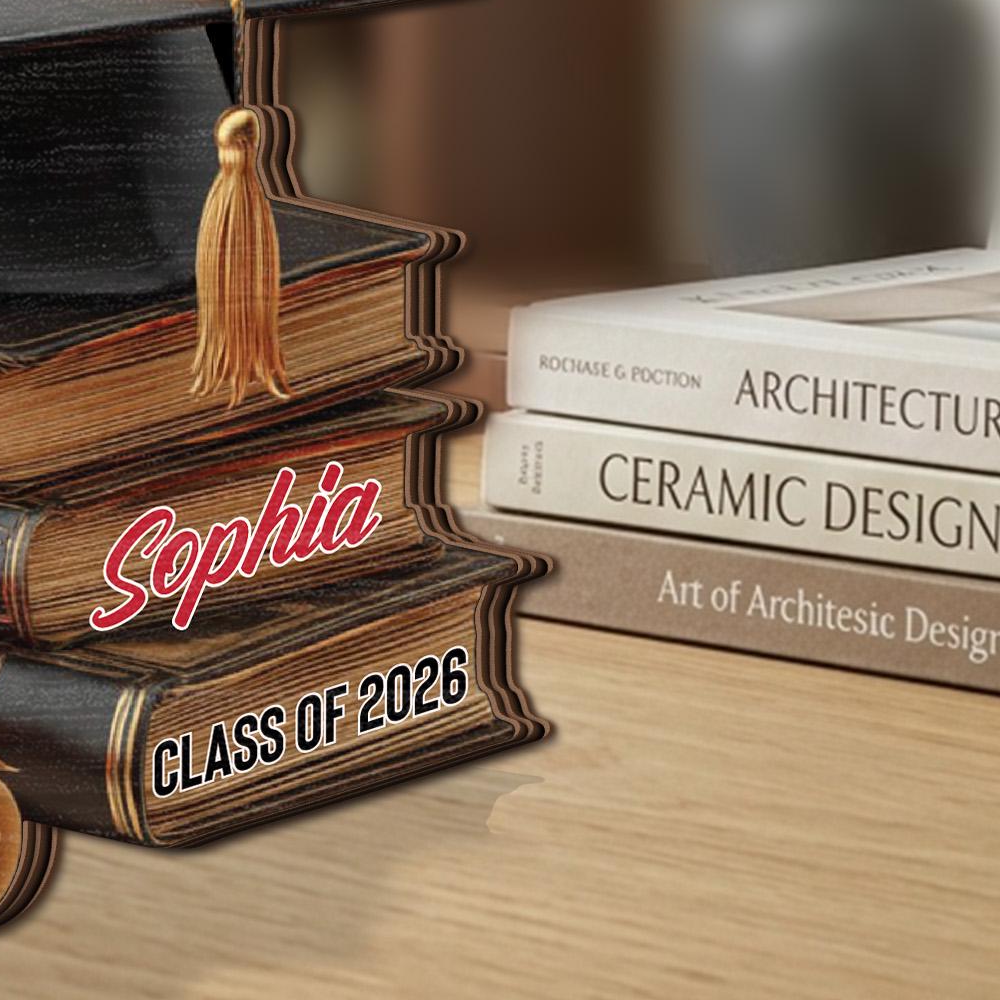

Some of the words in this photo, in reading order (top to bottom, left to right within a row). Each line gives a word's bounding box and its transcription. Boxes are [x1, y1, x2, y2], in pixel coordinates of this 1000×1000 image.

[734, 369, 1000, 438] ARCHITECTUR
[91, 462, 382, 630] Sophia
[599, 453, 807, 527] CERAMIC
[824, 482, 1000, 553] DESIGN
[657, 570, 702, 608] Art
[711, 580, 741, 613] of
[747, 585, 895, 639] Architesic
[152, 706, 286, 798] CLASS
[296, 682, 348, 753] OF
[357, 646, 468, 735] 2026
